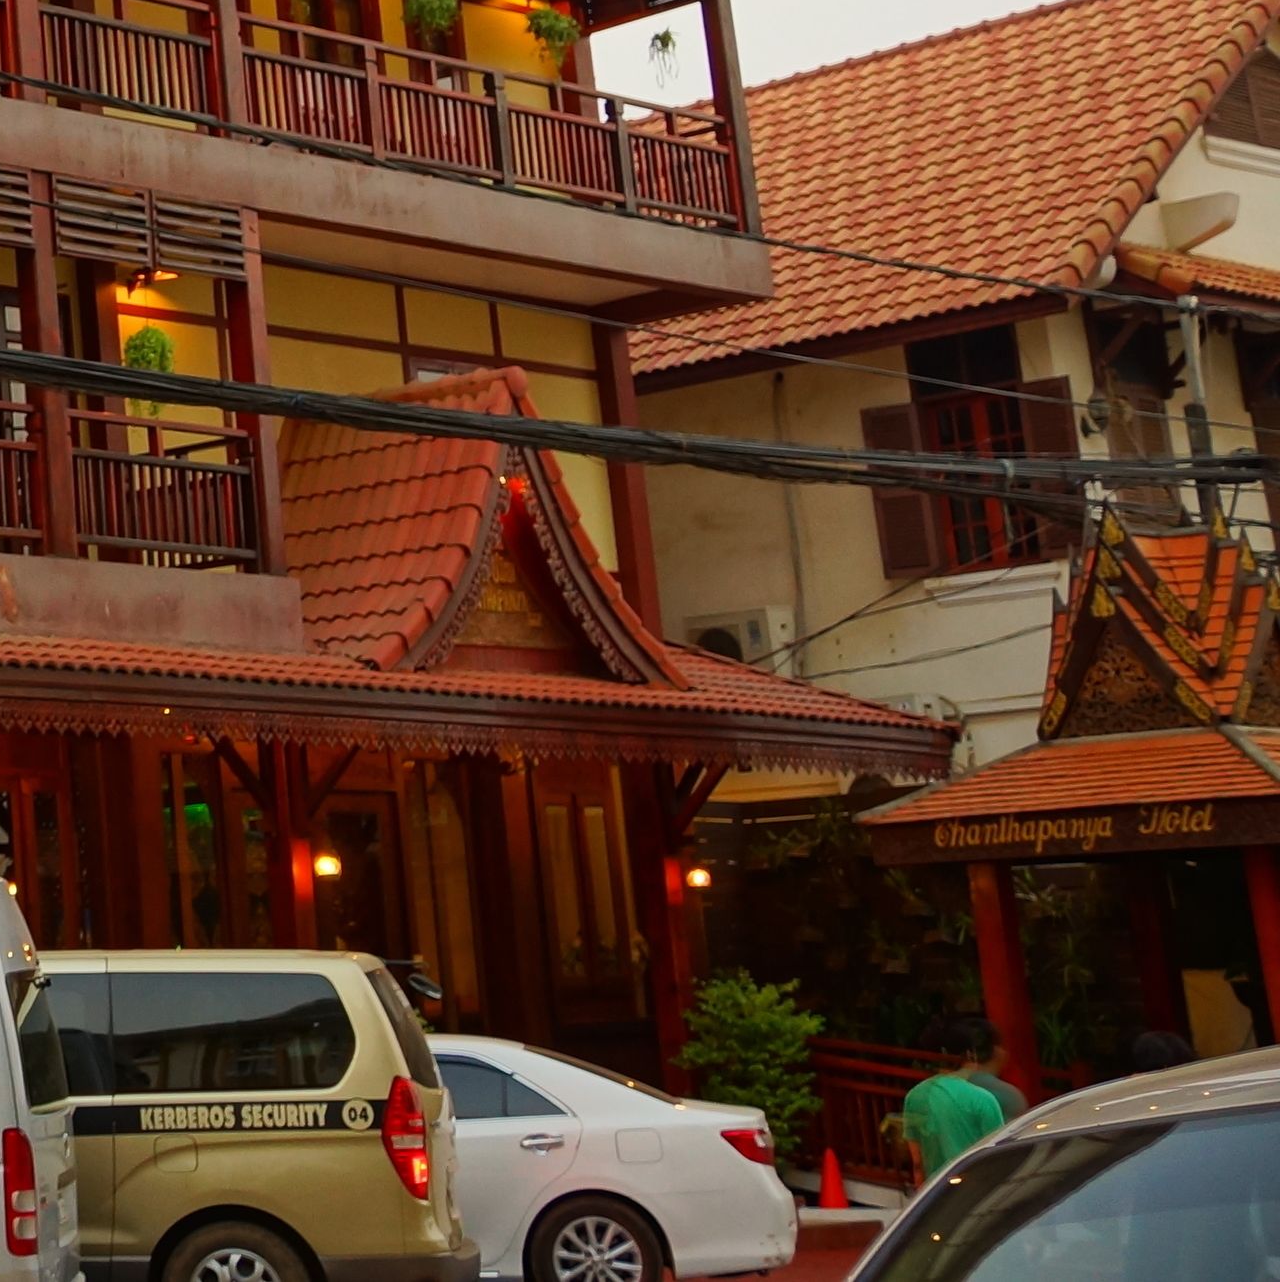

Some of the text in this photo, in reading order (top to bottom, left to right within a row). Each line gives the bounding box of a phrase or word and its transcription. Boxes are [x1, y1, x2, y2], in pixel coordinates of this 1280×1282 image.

[934, 803, 1214, 853] Chanthapanya Hotel
[140, 1103, 368, 1130] KERBEROS SECURITY 04
